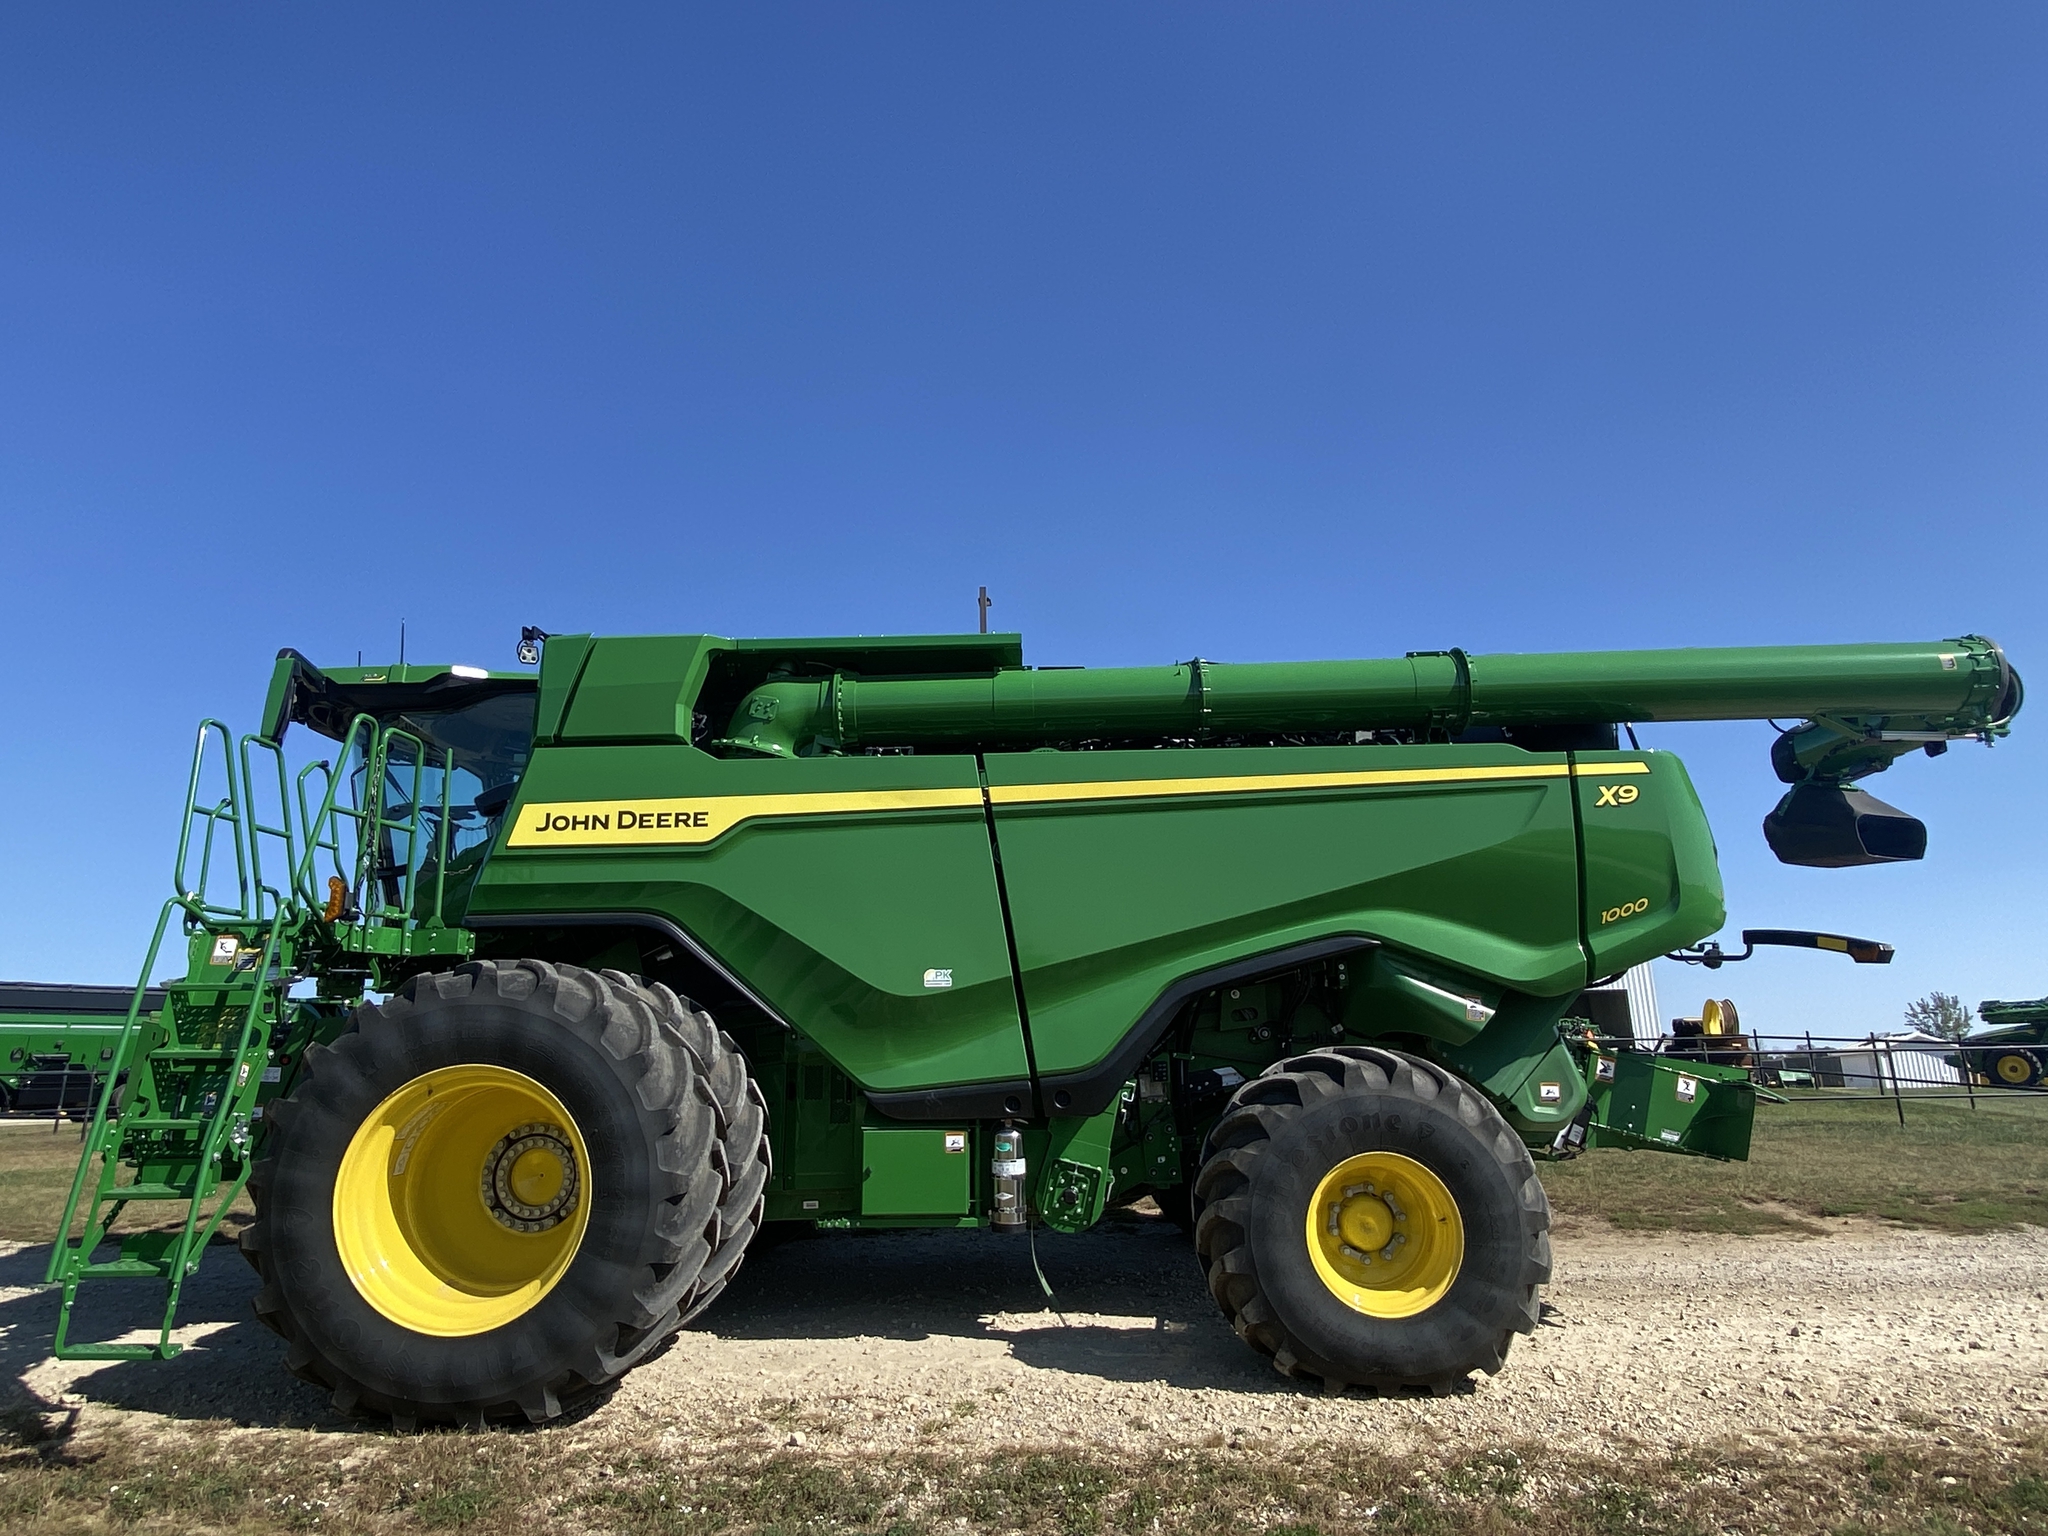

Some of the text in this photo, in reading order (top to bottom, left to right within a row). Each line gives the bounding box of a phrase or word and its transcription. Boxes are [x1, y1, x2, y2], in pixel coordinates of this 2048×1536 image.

[1594, 784, 1639, 807] X9
[536, 810, 709, 832] JOHN DEERE
[1601, 898, 1649, 925] 1000
